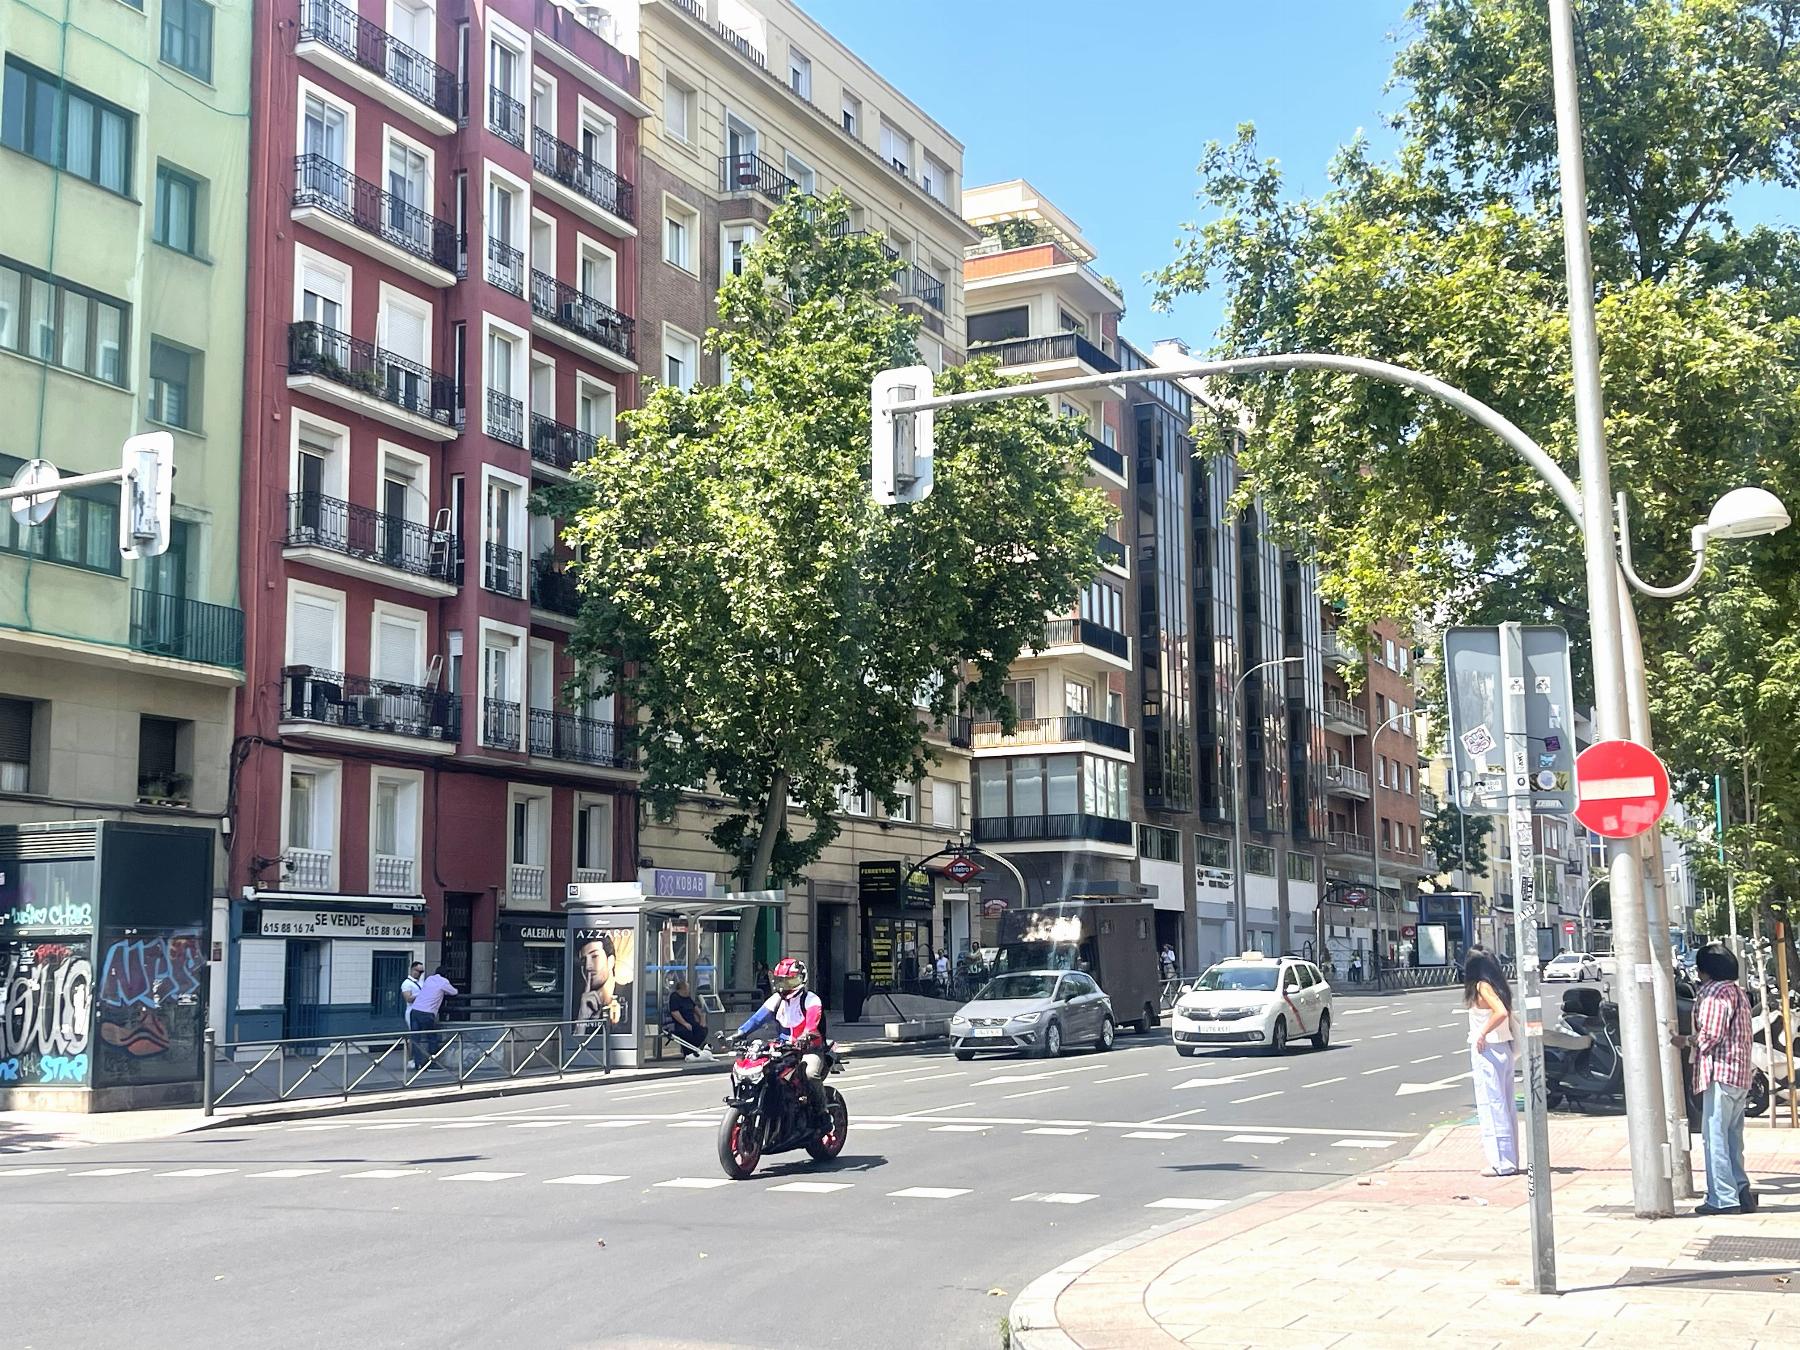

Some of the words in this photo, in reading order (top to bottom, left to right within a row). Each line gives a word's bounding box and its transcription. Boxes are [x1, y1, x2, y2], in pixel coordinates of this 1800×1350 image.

[675, 876, 704, 892] KOBAB
[315, 913, 328, 926] SE
[330, 914, 366, 927] VENDE
[263, 922, 279, 933] 615
[280, 923, 291, 933] 88
[293, 923, 303, 933] 16
[305, 923, 315, 933] 74
[365, 926, 380, 935] 615
[380, 926, 390, 936] 88
[392, 926, 401, 936] 16
[401, 926, 411, 936] 74
[520, 926, 555, 939] GALERÍA
[576, 929, 631, 939] AZZARO
